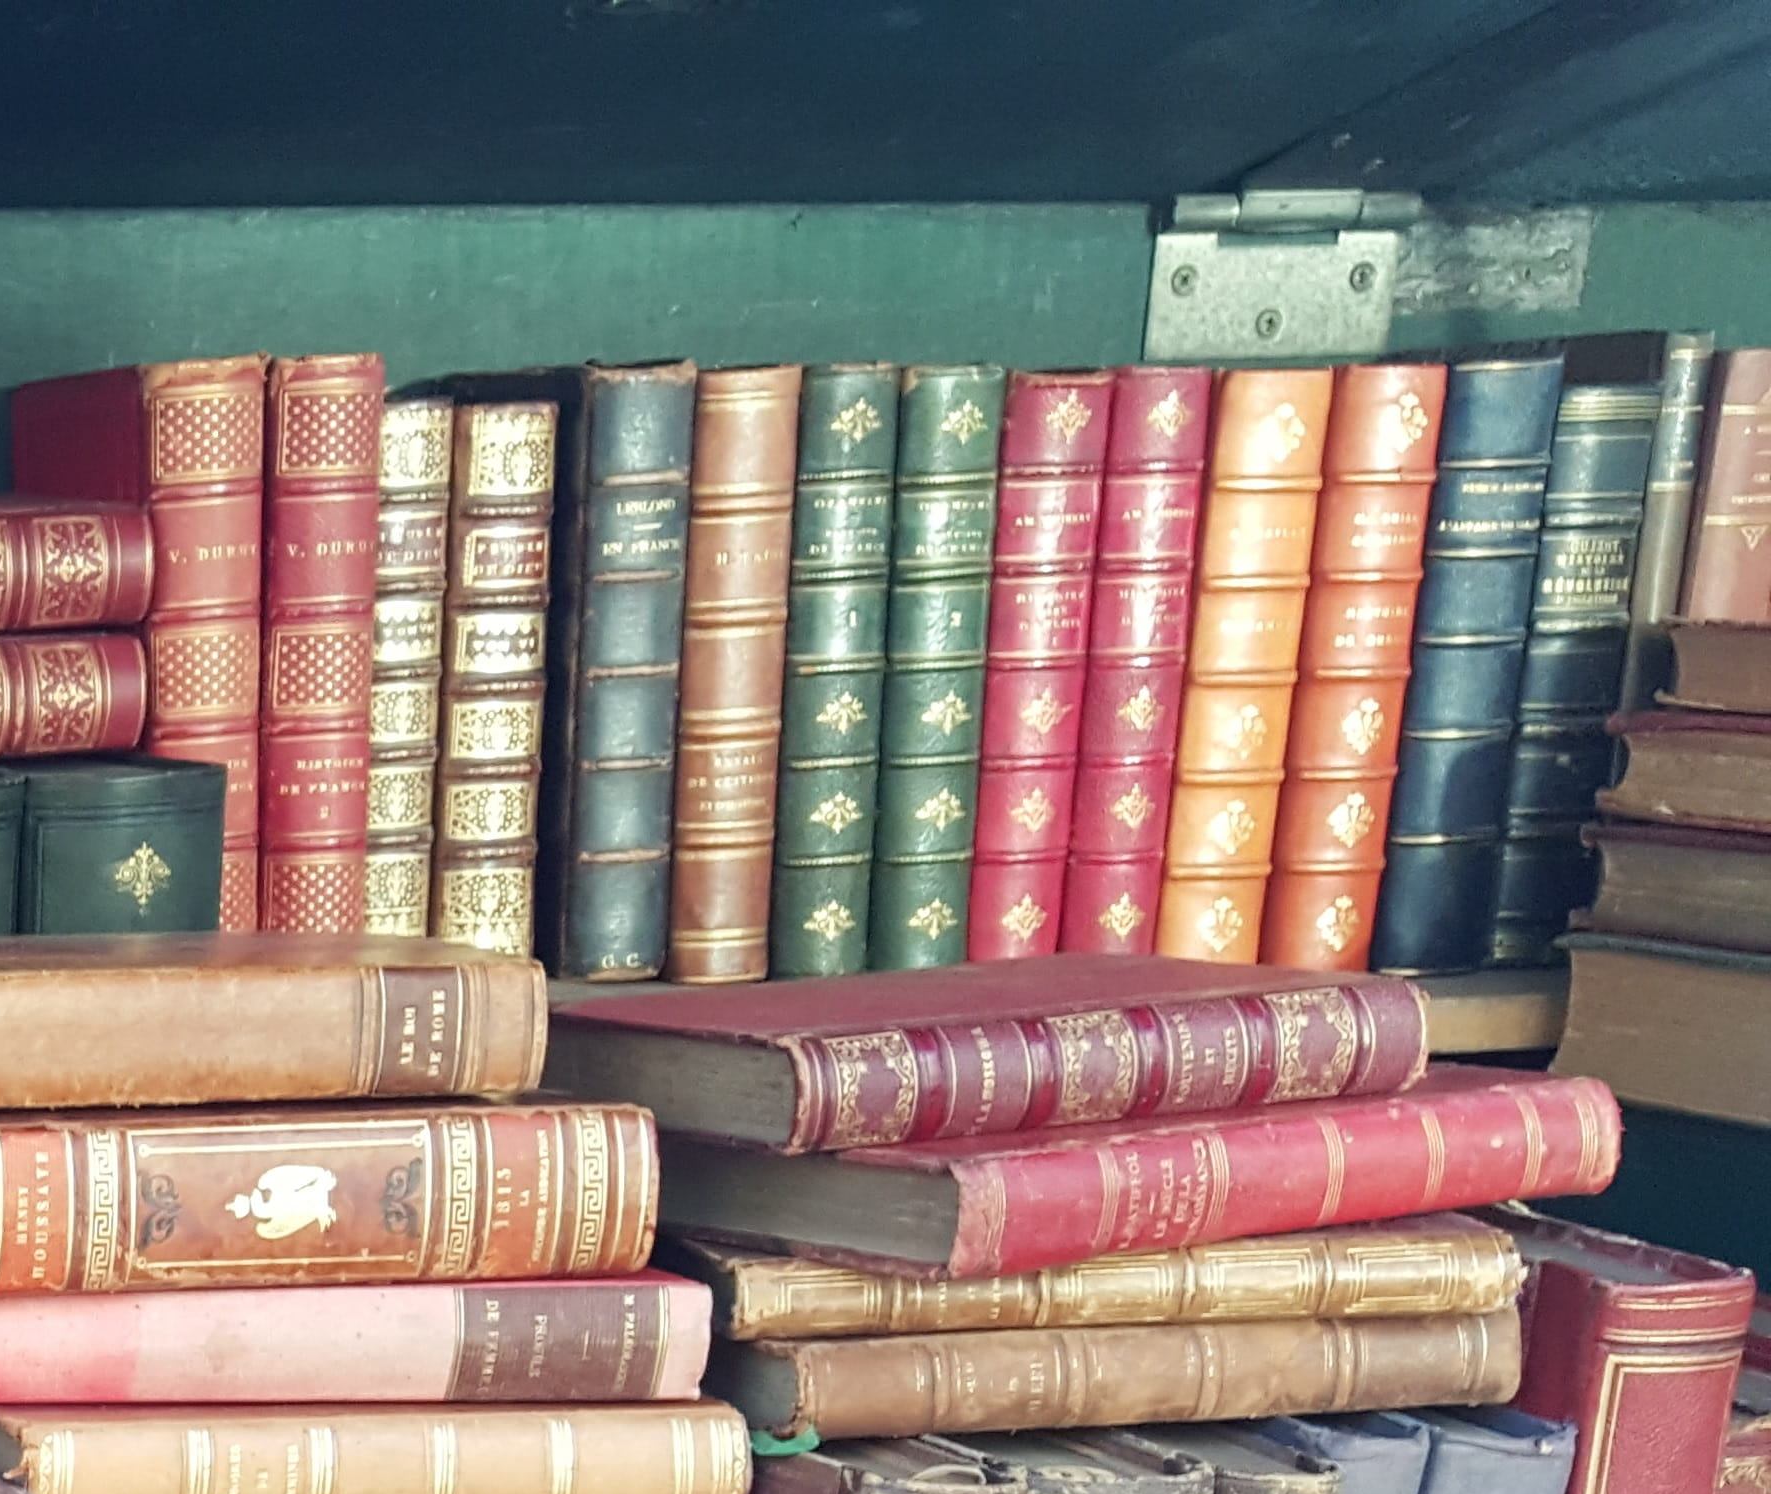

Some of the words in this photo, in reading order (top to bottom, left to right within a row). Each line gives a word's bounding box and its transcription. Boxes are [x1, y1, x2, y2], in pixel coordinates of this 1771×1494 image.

[401, 1007, 415, 1035] ROI
[430, 989, 445, 1041] ROME
[400, 1042, 415, 1064] LE
[33, 1151, 49, 1279] HOUSSAYE
[493, 1167, 512, 1231] 1815
